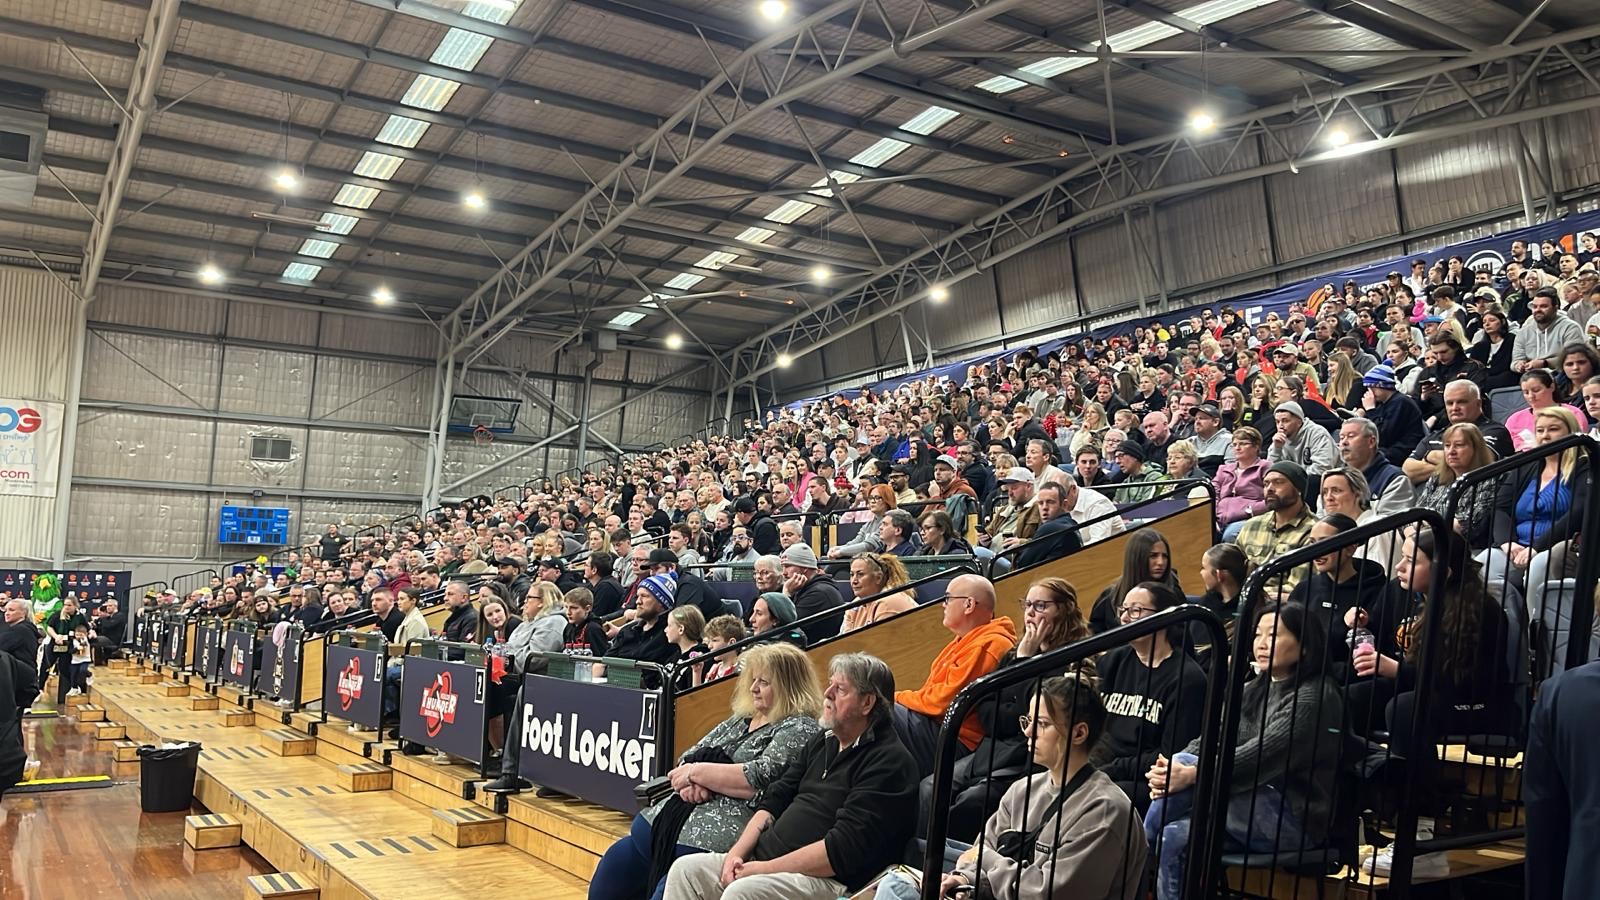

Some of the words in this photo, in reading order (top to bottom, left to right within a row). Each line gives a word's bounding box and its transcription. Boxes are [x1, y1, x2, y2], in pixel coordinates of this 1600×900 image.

[648, 702, 654, 728] 1
[521, 703, 563, 759] Foot
[569, 712, 656, 782] Locker
